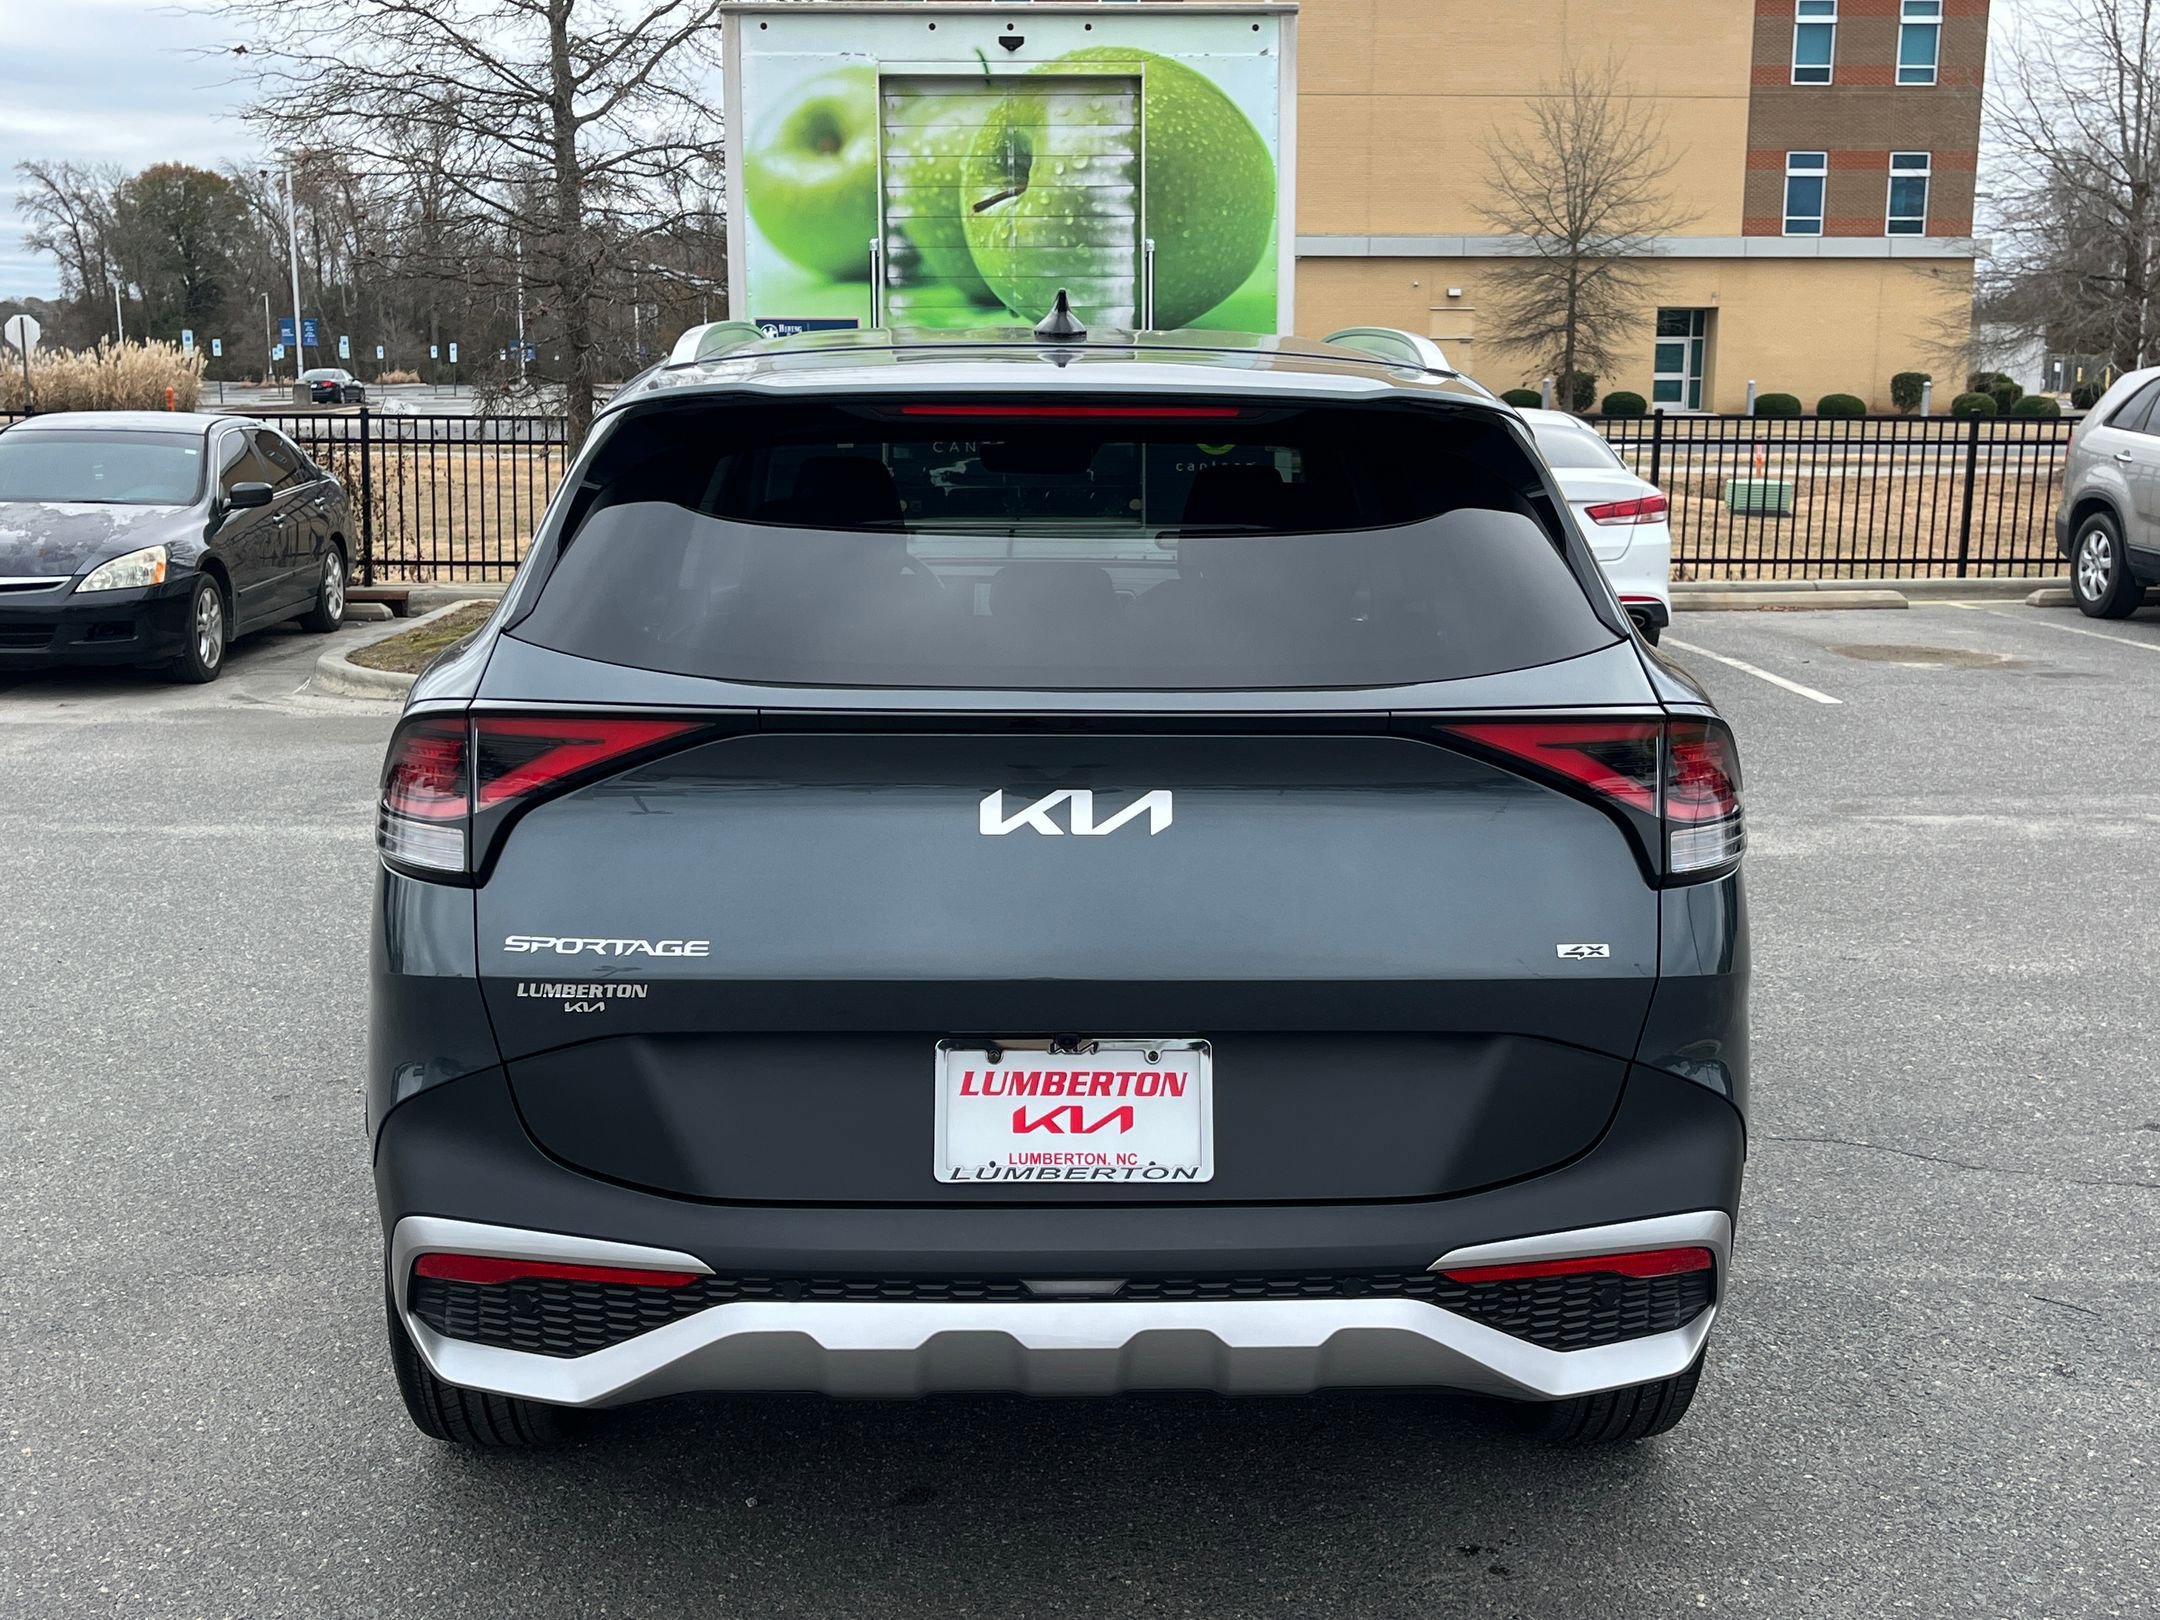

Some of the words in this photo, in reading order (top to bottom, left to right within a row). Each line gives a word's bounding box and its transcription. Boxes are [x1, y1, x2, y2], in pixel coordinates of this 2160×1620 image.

[979, 788, 1173, 836] KIA
[503, 935, 711, 957] SPORTAGE
[516, 982, 649, 998] LUMBERTON
[564, 1000, 606, 1013] KIA
[959, 1071, 1188, 1097] LUMBERTON
[1012, 1105, 1134, 1134] KIA
[1116, 1152, 1138, 1166] NC
[950, 1166, 1199, 1181] LUMBERTON
